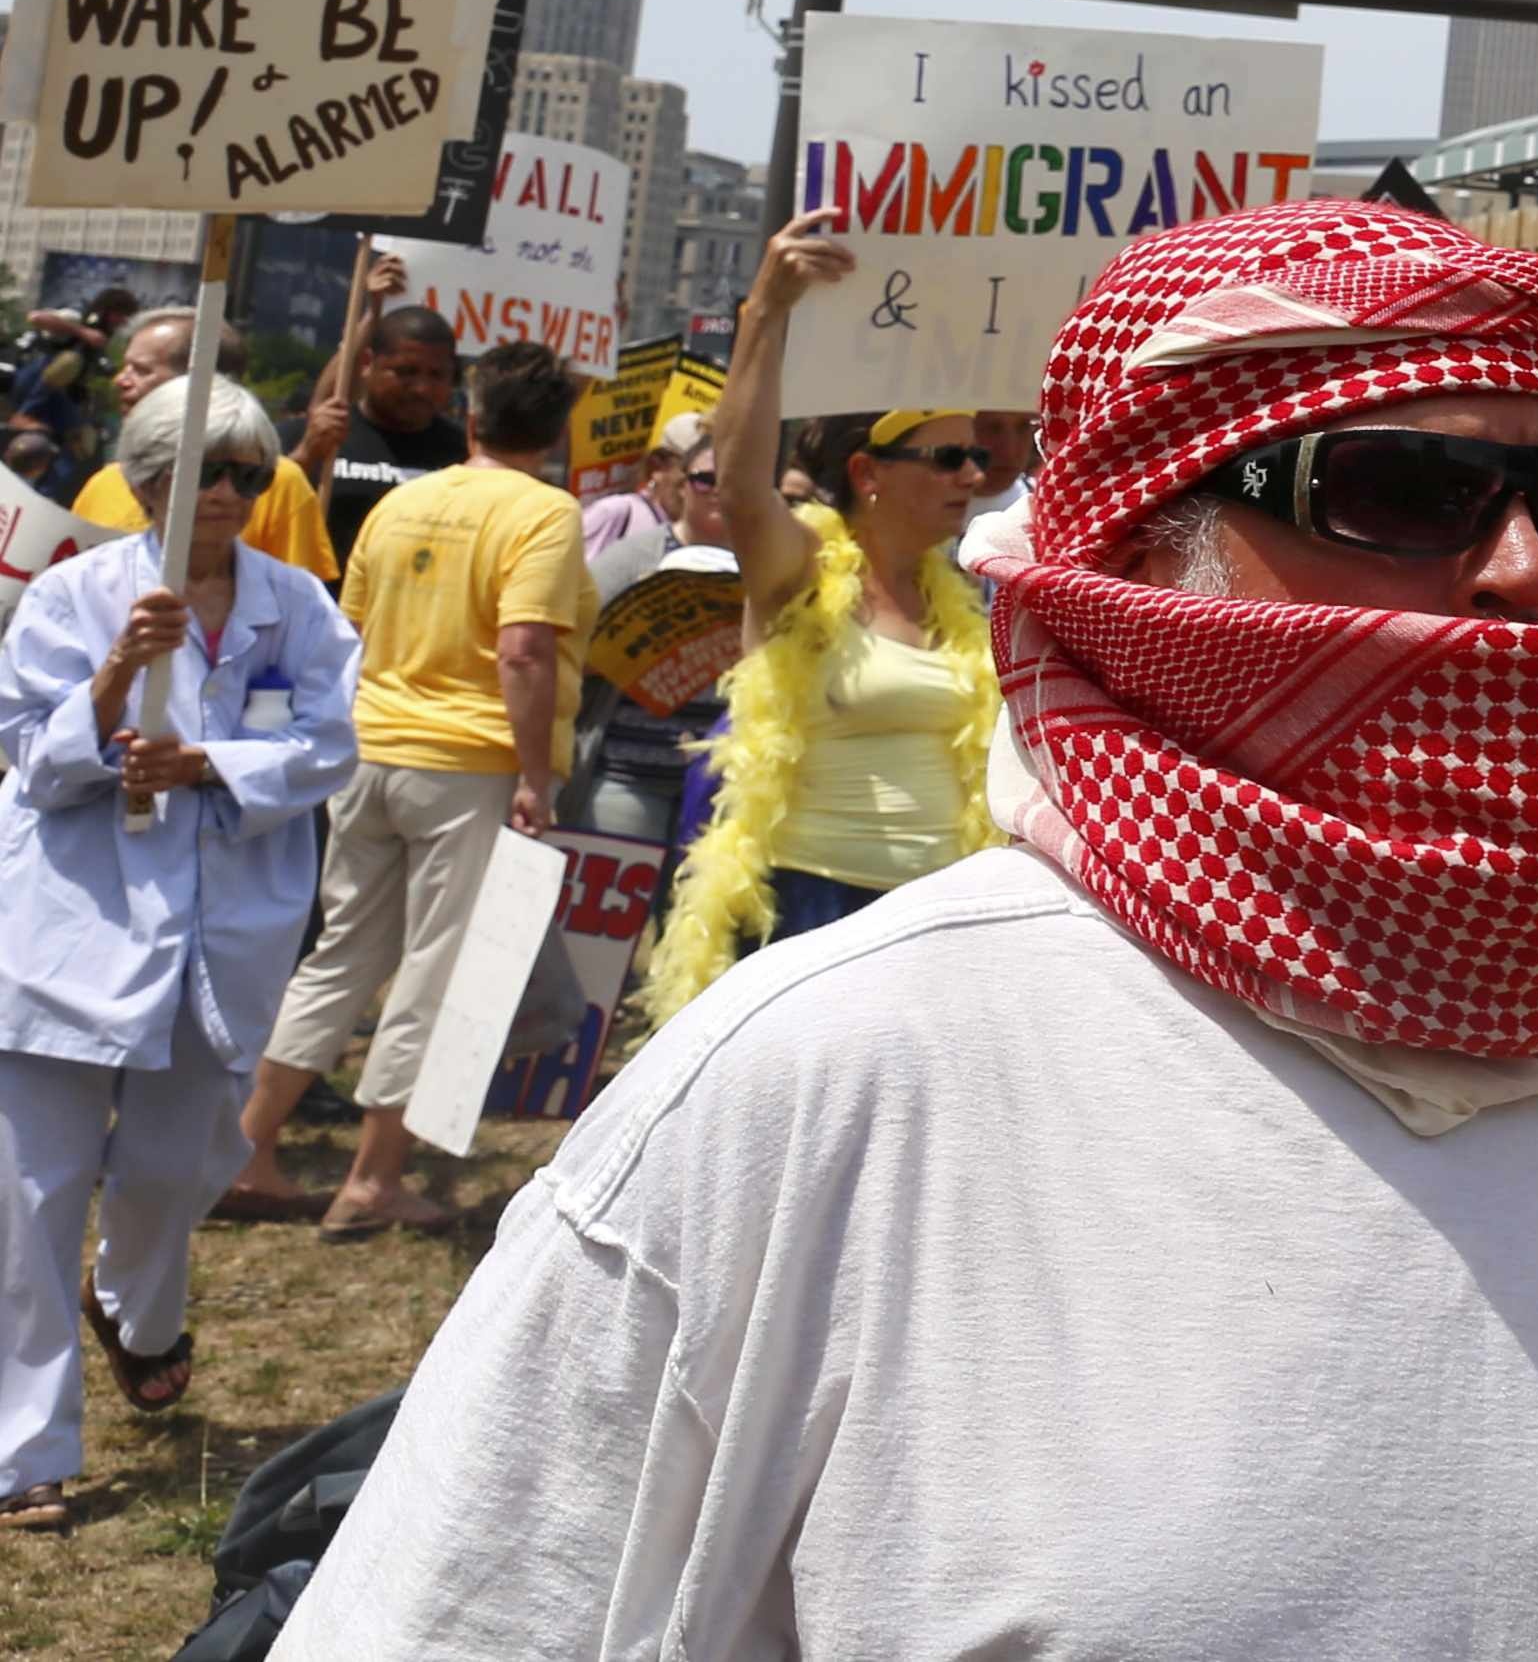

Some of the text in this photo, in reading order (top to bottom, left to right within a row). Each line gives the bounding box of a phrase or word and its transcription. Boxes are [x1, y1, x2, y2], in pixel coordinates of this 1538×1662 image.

[914, 52, 1230, 116] I kissed an
[63, 66, 229, 181] UP!
[225, 68, 440, 199] ALARMED
[805, 140, 1310, 236] IMMIGRANT
[872, 270, 918, 331] &
[591, 404, 656, 440] NEVE
